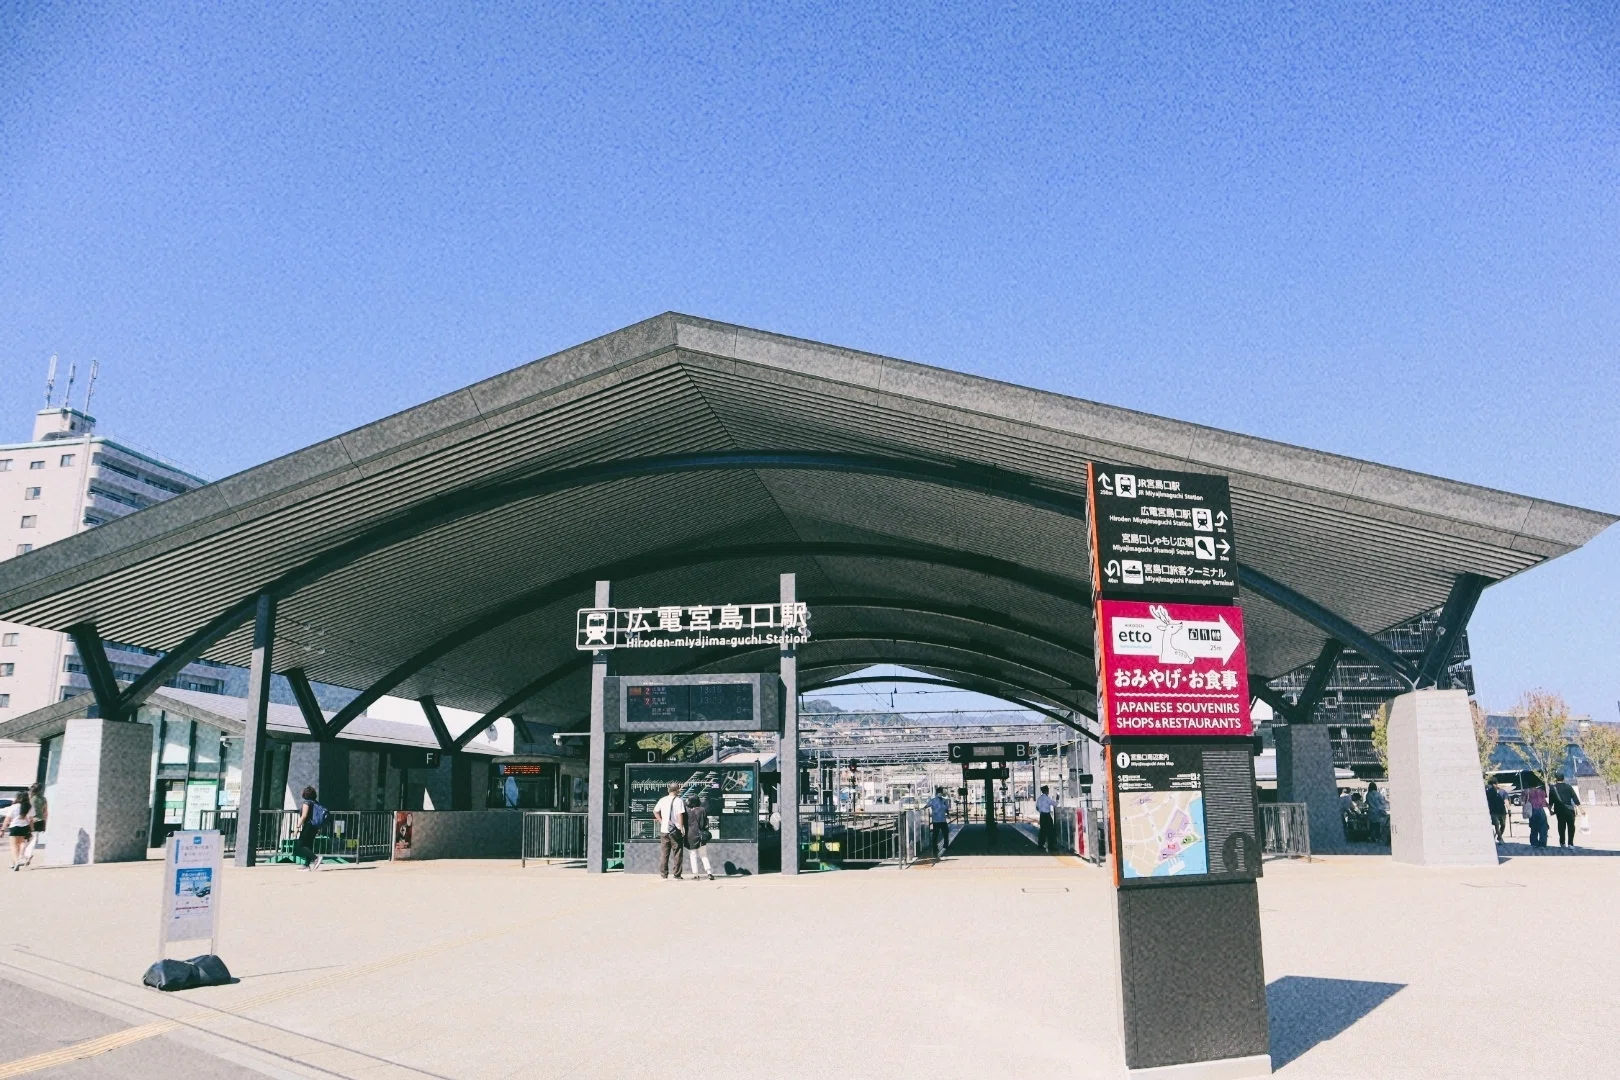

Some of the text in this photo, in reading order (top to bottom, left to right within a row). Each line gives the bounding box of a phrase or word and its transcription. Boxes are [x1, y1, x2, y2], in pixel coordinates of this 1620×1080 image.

[1137, 478, 1180, 491] JR宮島口駅
[1145, 490, 1183, 500] Miyajimaguchi
[1184, 493, 1204, 501] Station
[1140, 506, 1191, 519] 広電宮島口駅
[1109, 514, 1132, 523] Hiroden
[1133, 517, 1172, 526] Miyajimaguchi
[1121, 533, 1194, 548] 宮島口しゃもじ広場
[1112, 544, 1195, 556] Miyajimaguchi Shamoji Square
[1144, 563, 1227, 578] 宮島口旅客ターミナル
[1145, 575, 1235, 587] Miyajimaguchi Passenger Terminal
[626, 602, 808, 633] 広電宮島口駅
[626, 633, 808, 649] Hiroden-miyajima-guchi Station
[1118, 630, 1152, 643] etto
[1210, 644, 1223, 652] 25m
[1114, 668, 1238, 690] おみやげ・お食事
[1116, 702, 1240, 715] JAPANESE SOUVENIRS
[647, 751, 655, 763] D
[953, 745, 961, 758] C
[1017, 744, 1026, 757] B
[426, 753, 433, 764] F
